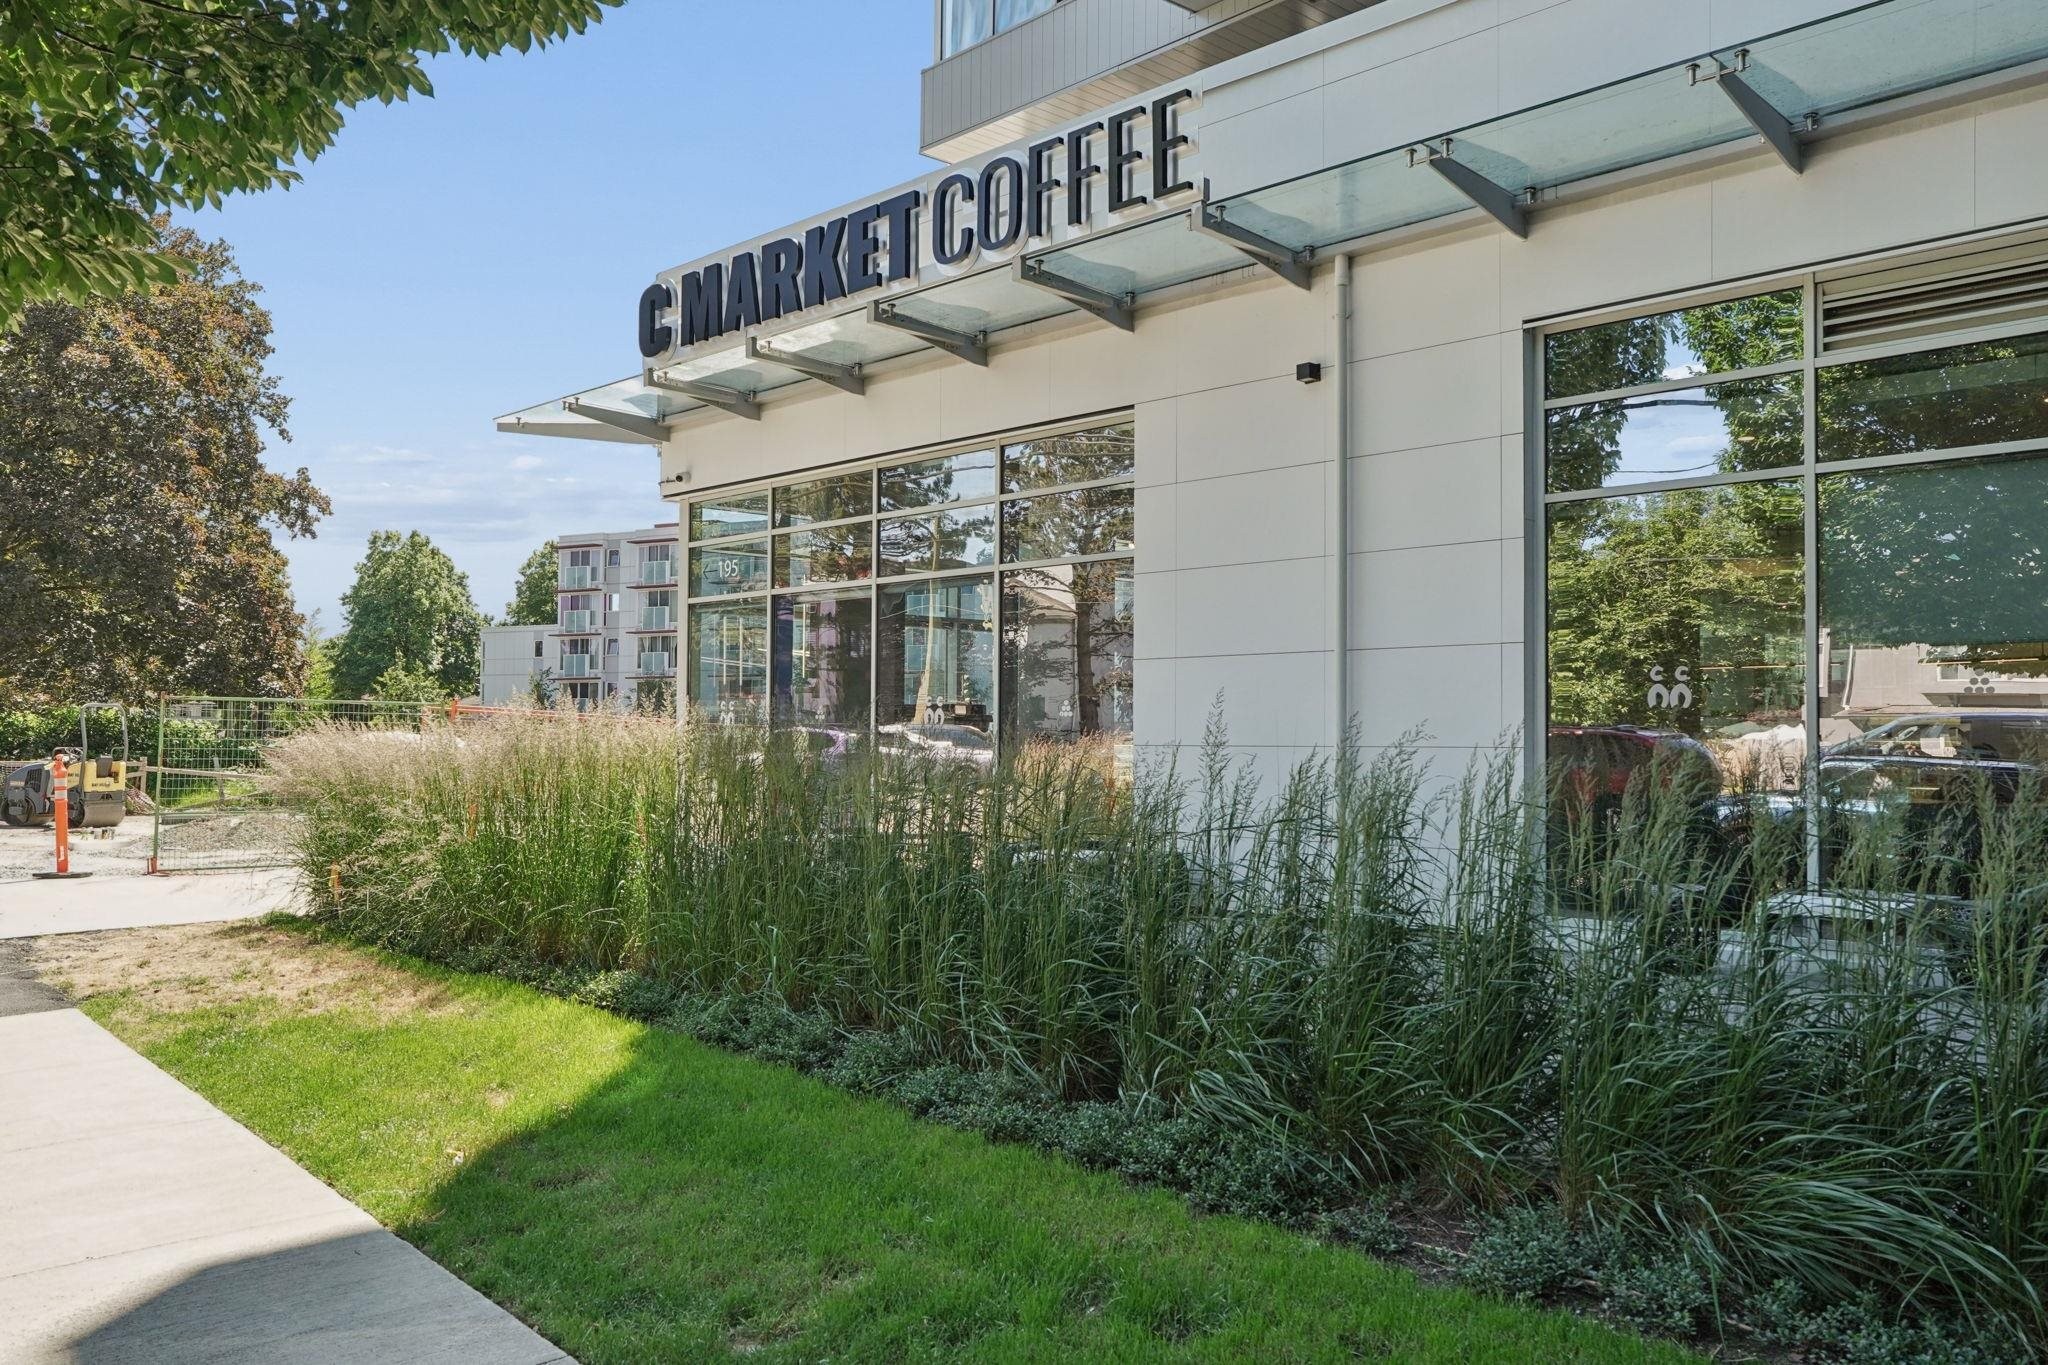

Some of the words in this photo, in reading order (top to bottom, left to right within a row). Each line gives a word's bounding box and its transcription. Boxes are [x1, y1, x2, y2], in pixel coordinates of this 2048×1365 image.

[639, 283, 672, 358] C
[681, 190, 921, 347] MARKET
[932, 88, 1193, 265] COFFEE
[718, 559, 738, 578] 195
